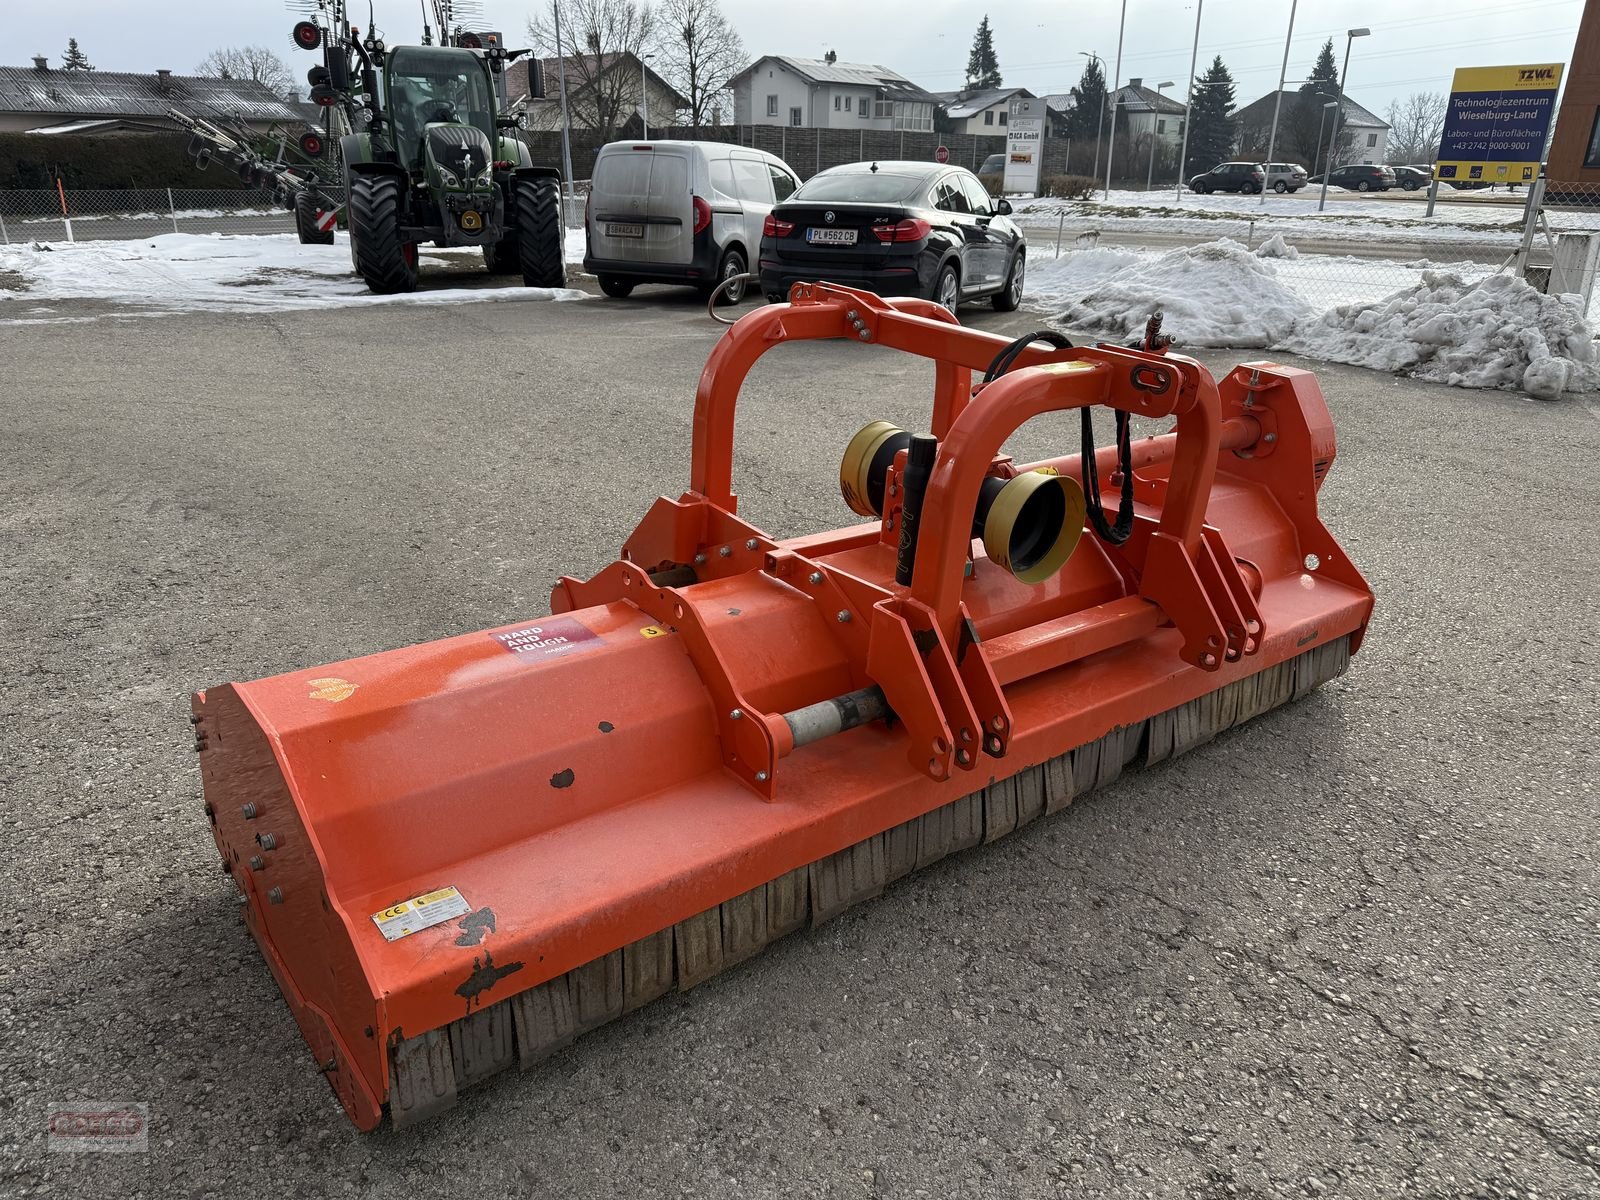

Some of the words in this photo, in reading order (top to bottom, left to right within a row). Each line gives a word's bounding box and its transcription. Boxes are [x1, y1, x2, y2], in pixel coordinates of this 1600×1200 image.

[1519, 68, 1553, 80] TZWL
[1453, 97, 1549, 108] Technologiezentrum
[1458, 109, 1539, 121] Wieselburg-Land
[1447, 130, 1472, 138] Labor-
[1473, 129, 1490, 138] und
[1491, 128, 1542, 138] Büroflächen
[1452, 142, 1466, 150] +43
[1467, 142, 1487, 150] 2742
[1488, 142, 1530, 150] 9000-9001
[814, 230, 822, 240] PL
[828, 231, 843, 240] 562
[844, 232, 854, 240] CB
[498, 626, 543, 641] HARD
[507, 635, 540, 648] AND
[512, 636, 568, 652] TOUGH
